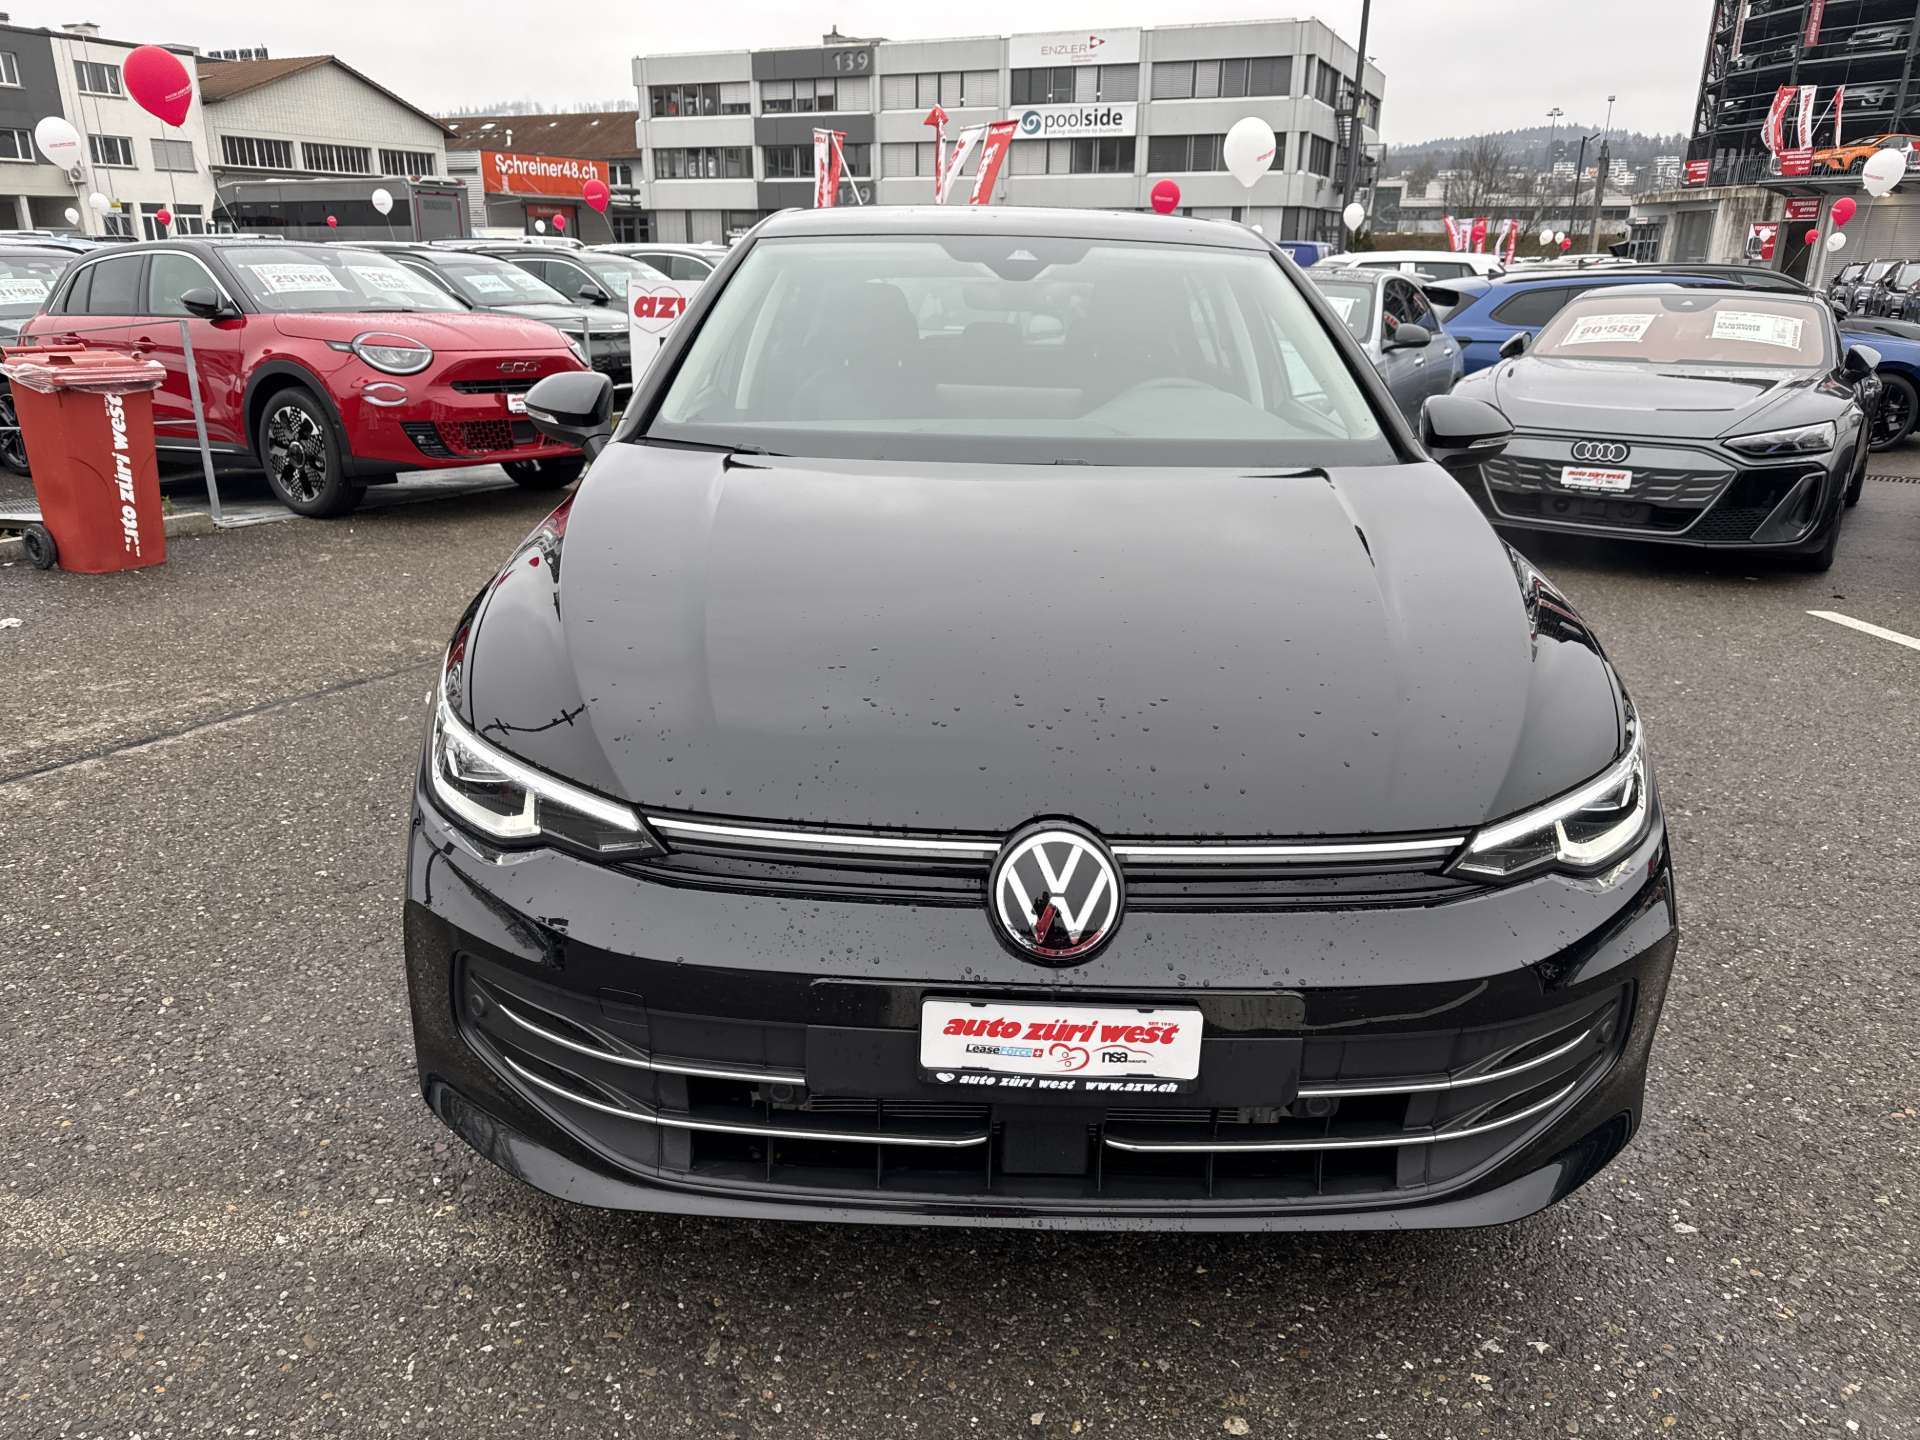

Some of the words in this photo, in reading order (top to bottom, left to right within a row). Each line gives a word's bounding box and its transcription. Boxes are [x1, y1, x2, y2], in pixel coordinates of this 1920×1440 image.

[832, 51, 869, 71] 139
[1041, 44, 1087, 55] ENZLER
[1045, 107, 1123, 135] poolside
[495, 154, 598, 180] Schreiner48.ch
[112, 452, 135, 504] züri
[943, 1017, 1022, 1039] auto
[1022, 1019, 1099, 1043] züri
[1100, 1024, 1180, 1045] west
[1101, 1051, 1128, 1064] nsa
[959, 1075, 996, 1086] auto
[999, 1076, 1035, 1088] züri
[1039, 1080, 1076, 1090] west
[1085, 1081, 1178, 1093] www.azw.ch
